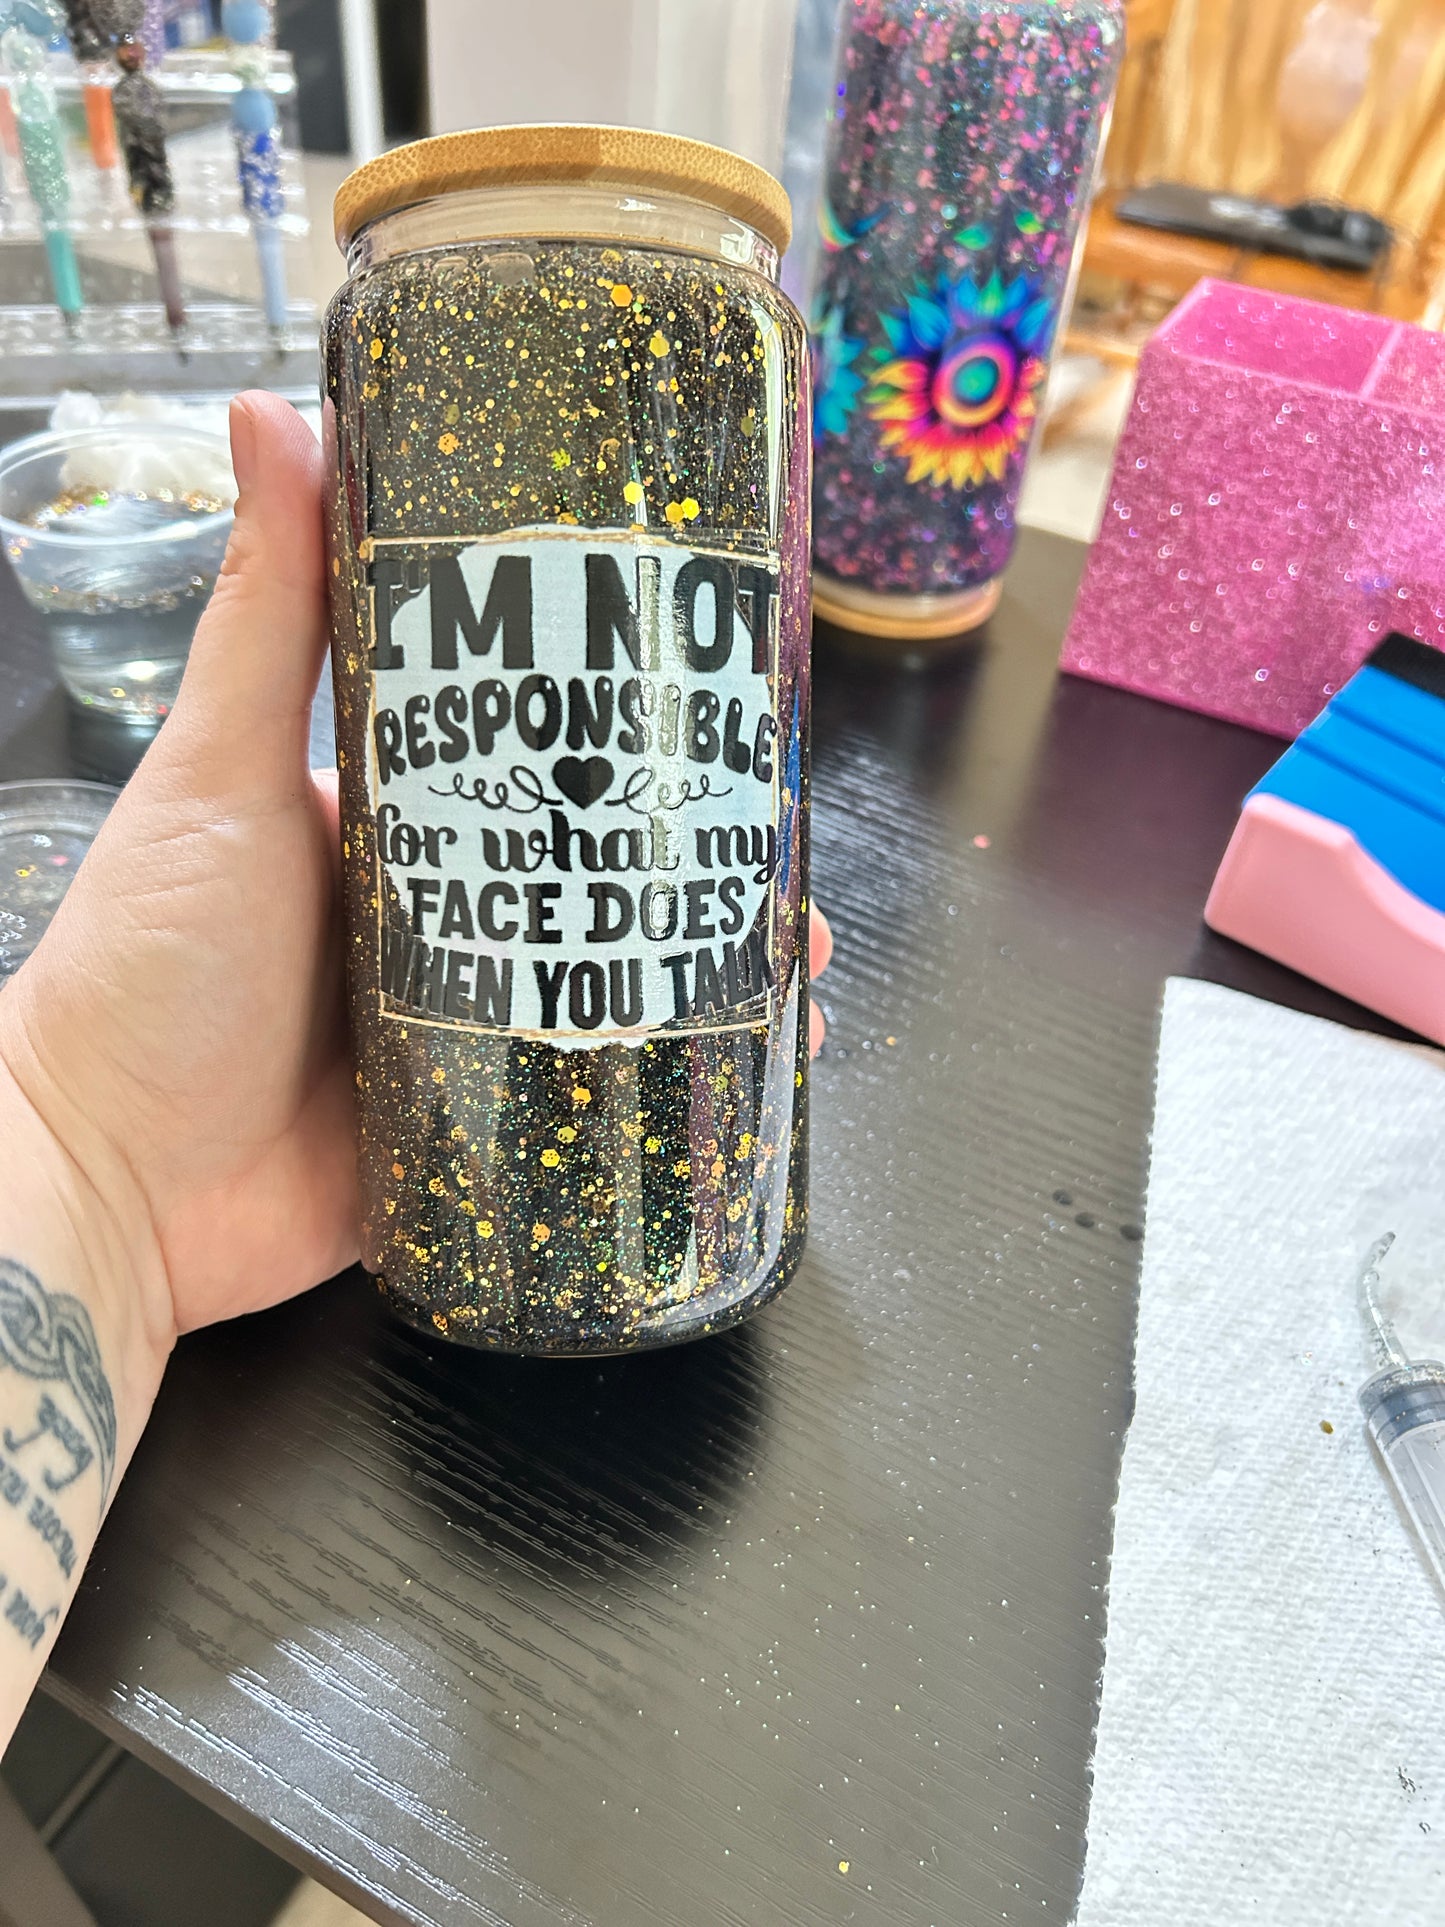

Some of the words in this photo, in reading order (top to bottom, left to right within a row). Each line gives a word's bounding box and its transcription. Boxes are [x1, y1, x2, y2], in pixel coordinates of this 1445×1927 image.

[366, 554, 535, 670] I'M
[584, 553, 780, 675] NOT
[374, 673, 778, 786] RESPONSIBLE
[376, 803, 459, 867] for
[481, 808, 680, 873] what
[695, 824, 780, 885] my
[407, 877, 563, 944] FACE
[585, 876, 746, 943] DOES
[380, 929, 514, 1026] WHEN
[532, 958, 644, 1030] YOU
[659, 923, 778, 1020] TALK
